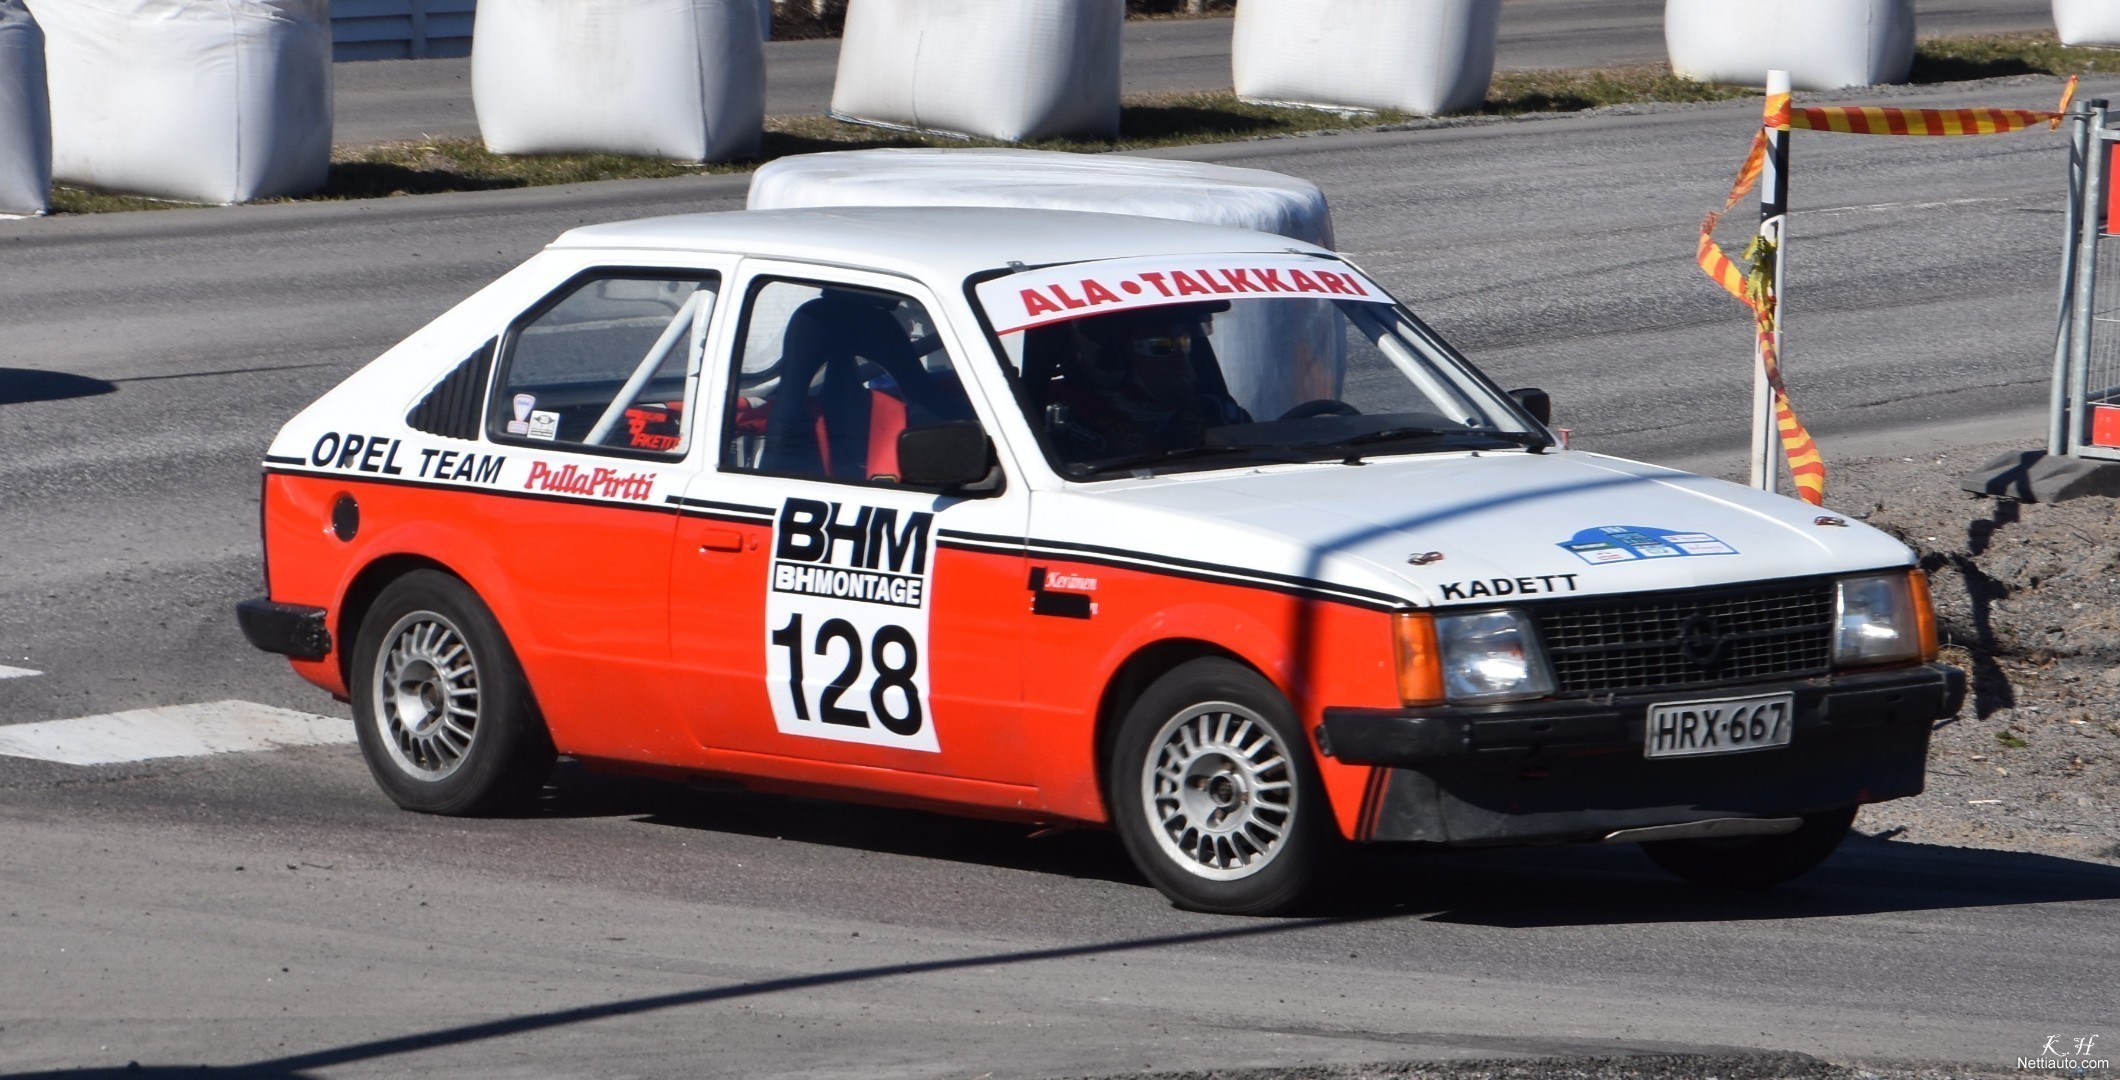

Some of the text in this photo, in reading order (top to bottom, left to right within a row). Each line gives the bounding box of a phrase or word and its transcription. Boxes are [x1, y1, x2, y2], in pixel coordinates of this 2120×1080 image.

[1019, 268, 1370, 317] ALA TALKKARI
[311, 431, 506, 484] OPEL TEAM
[524, 460, 658, 501] PullaPirtti
[776, 496, 935, 576] BHM
[1439, 573, 1578, 601] KADETT
[772, 612, 923, 737] 128
[1656, 702, 1787, 751] HRX-667
